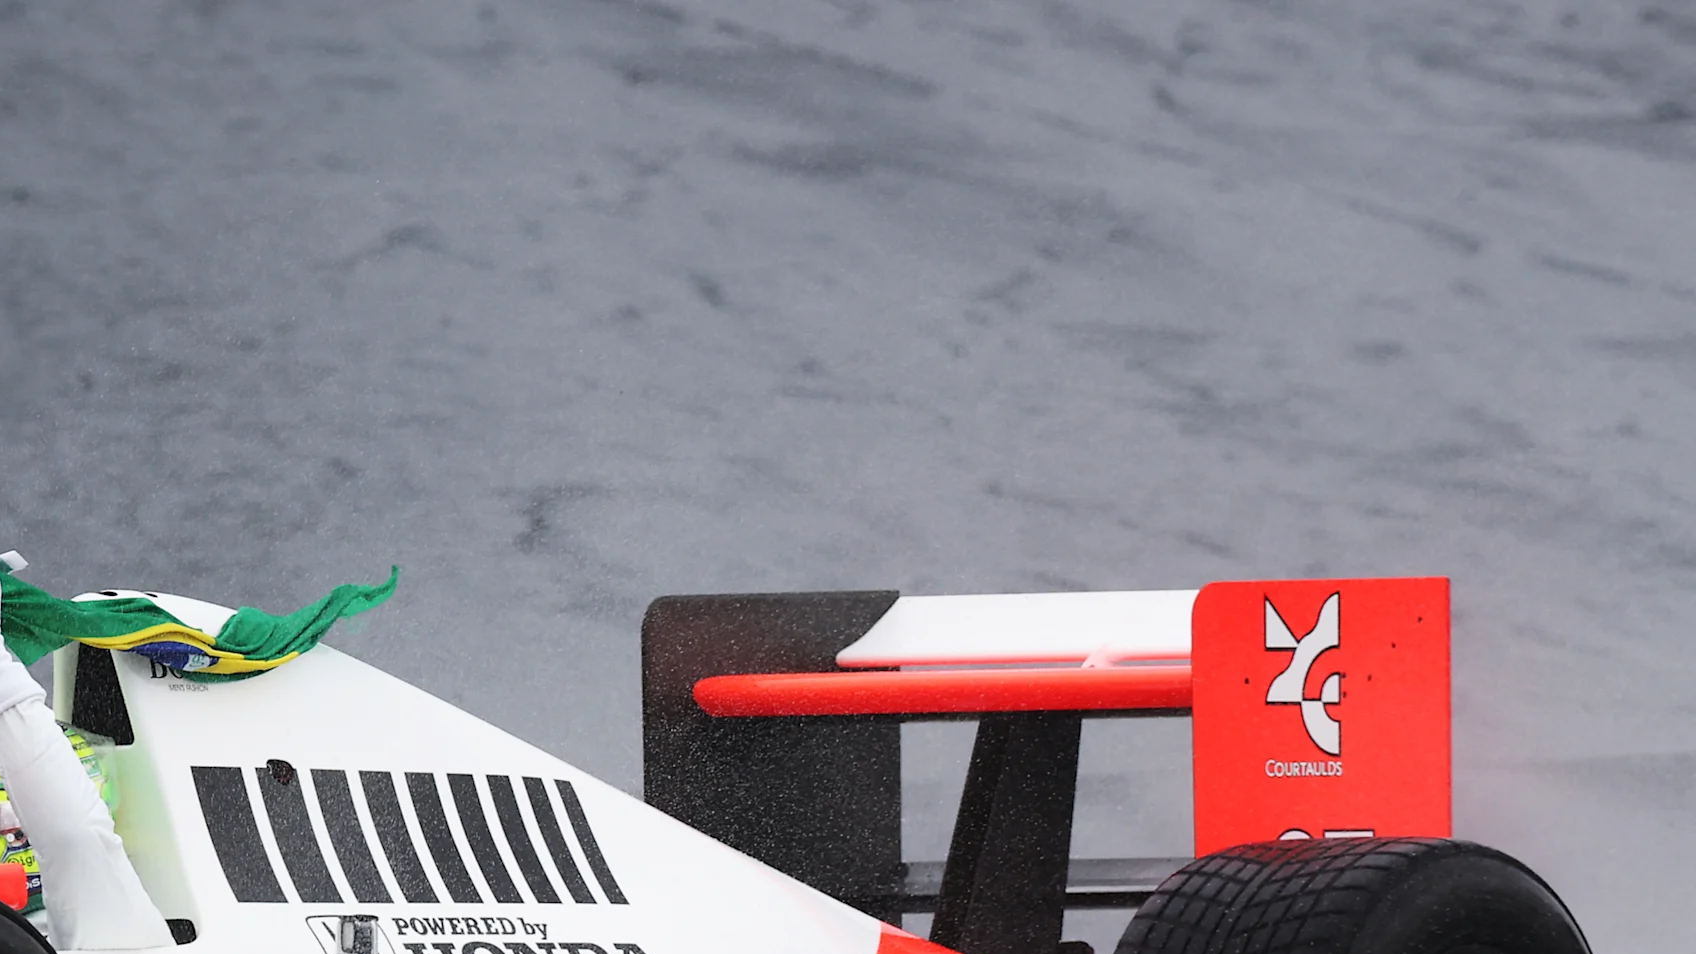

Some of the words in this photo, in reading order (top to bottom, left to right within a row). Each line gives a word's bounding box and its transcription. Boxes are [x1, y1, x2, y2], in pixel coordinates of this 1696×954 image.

[1264, 759, 1343, 777] COURTAULDS
[392, 917, 516, 936] POWERED
[518, 918, 548, 940] by
